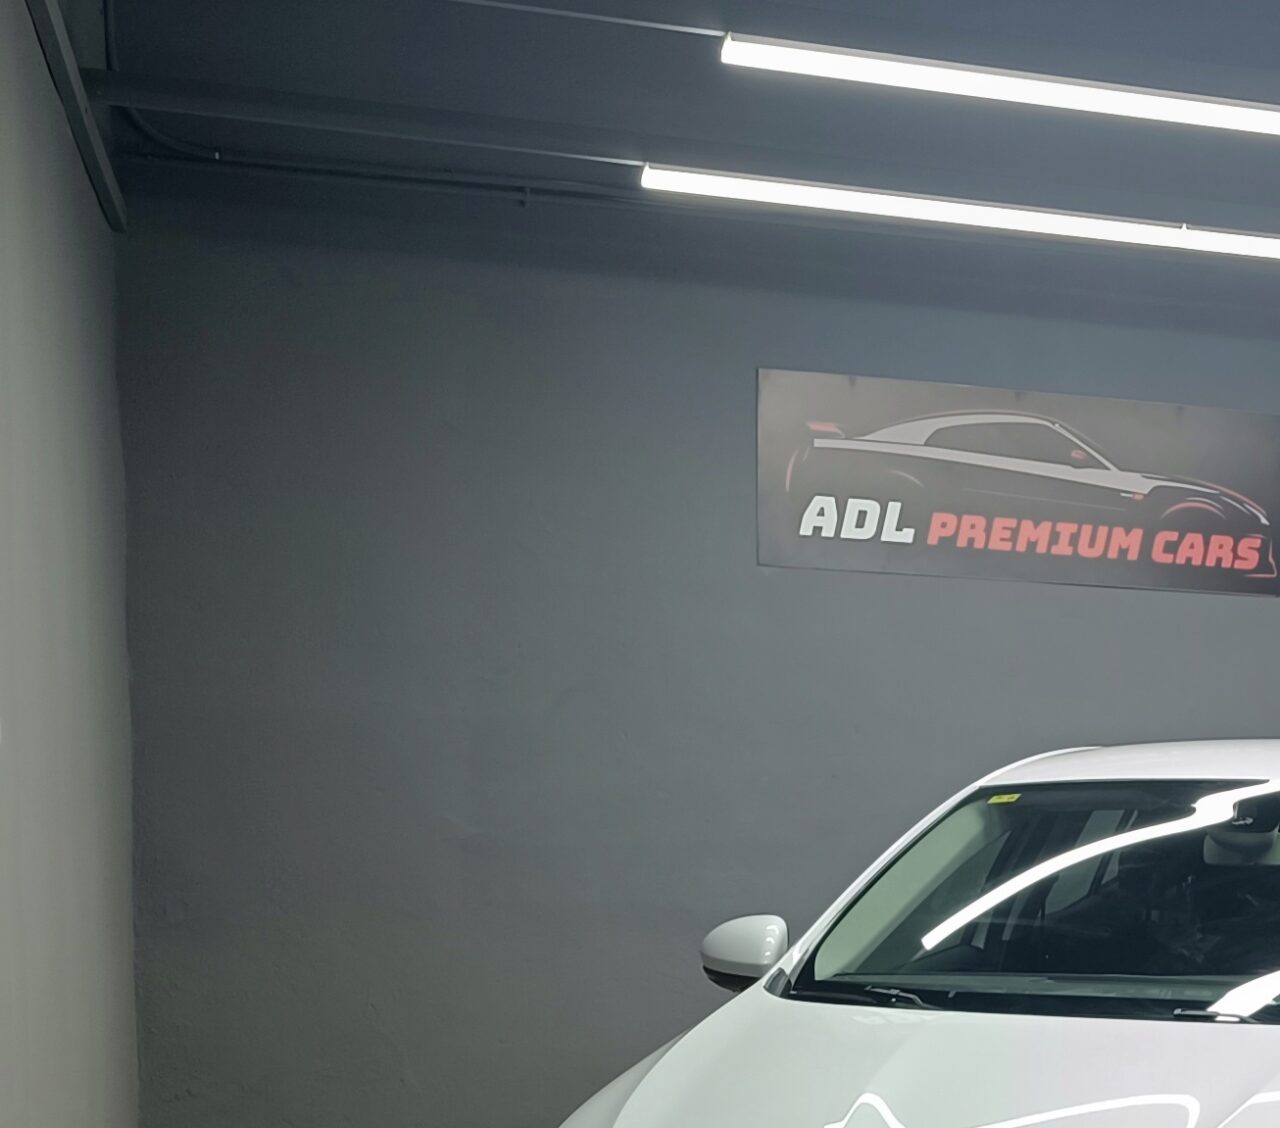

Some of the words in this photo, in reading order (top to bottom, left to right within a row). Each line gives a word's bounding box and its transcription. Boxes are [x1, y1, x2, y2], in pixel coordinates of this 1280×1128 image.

[799, 494, 915, 544] ADL
[927, 512, 1143, 561] PREMIUM
[1150, 530, 1262, 570] CARS
